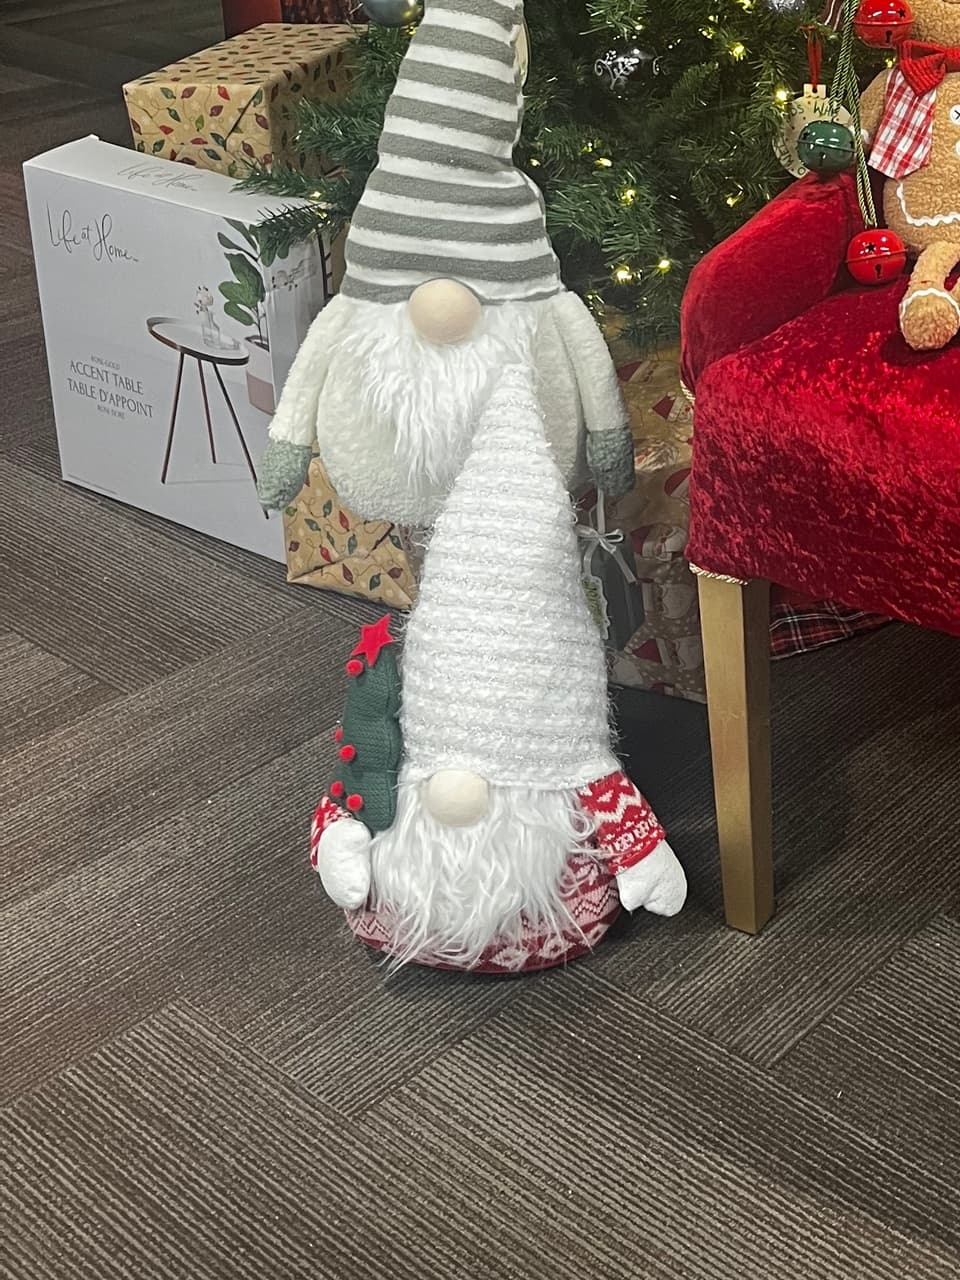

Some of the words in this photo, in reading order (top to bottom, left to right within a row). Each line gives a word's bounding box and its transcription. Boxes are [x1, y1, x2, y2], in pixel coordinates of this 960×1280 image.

[70, 359, 109, 385] ACCENT
[111, 372, 144, 396] TABLE
[66, 377, 97, 400] TABLE
[99, 388, 153, 419] D'APPOINT
